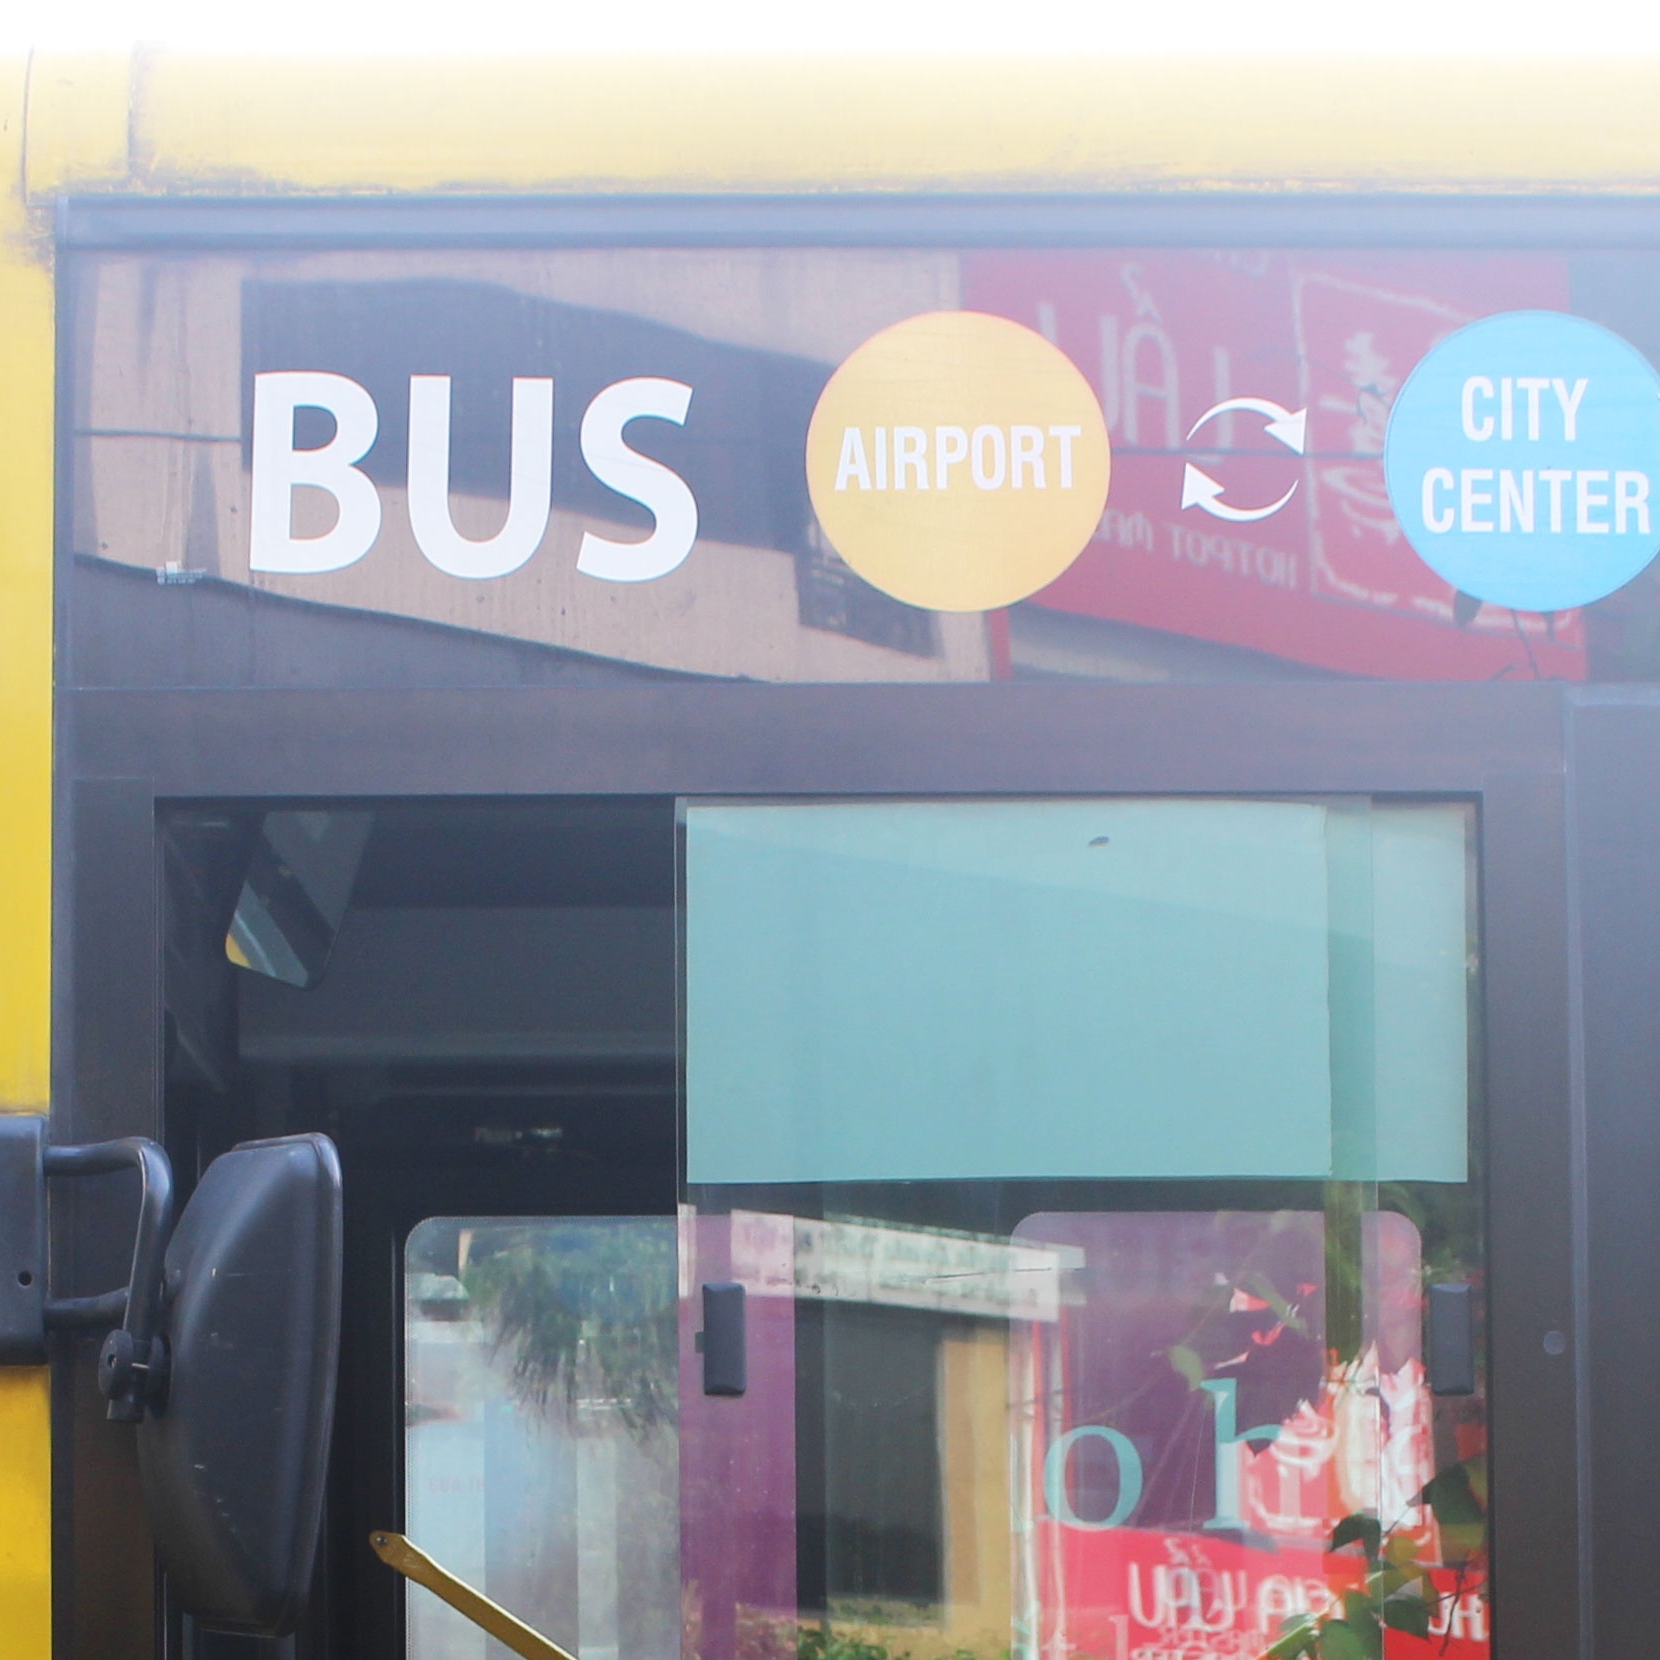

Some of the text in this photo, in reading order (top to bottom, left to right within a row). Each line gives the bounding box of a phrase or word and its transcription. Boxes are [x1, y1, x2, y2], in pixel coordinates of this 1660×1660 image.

[1461, 376, 1588, 442] CITY
[249, 370, 699, 584] BUS
[834, 424, 1083, 491] AIRPORT
[1421, 467, 1651, 535] CENTER
